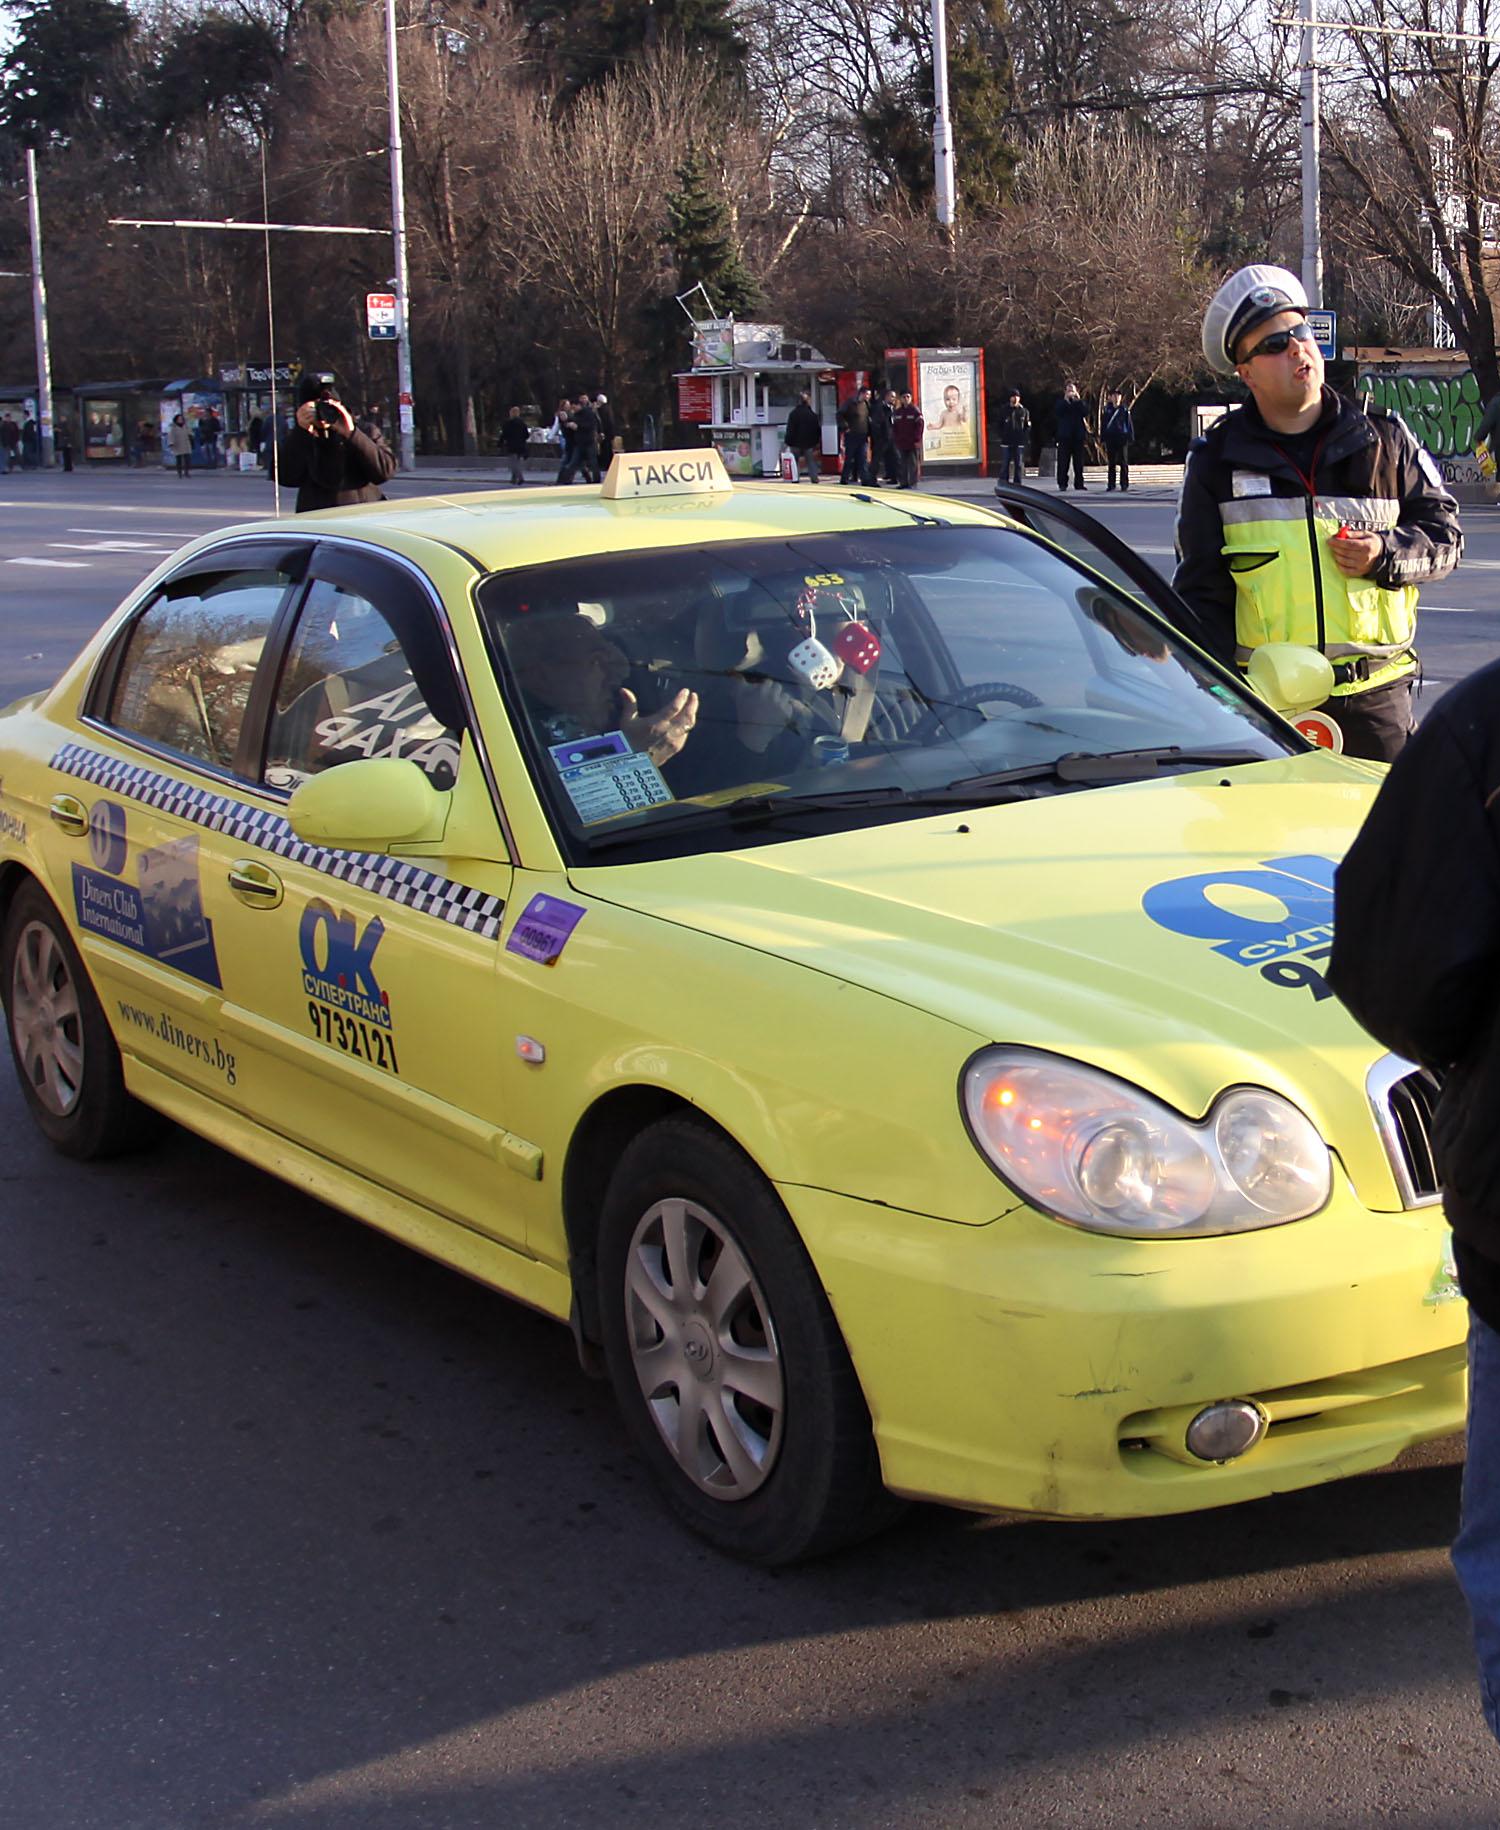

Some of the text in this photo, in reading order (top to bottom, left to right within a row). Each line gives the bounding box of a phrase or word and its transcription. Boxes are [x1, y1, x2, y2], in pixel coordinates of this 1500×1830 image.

[628, 461, 713, 486] ТАКСИ
[82, 875, 137, 920] Diners Club
[82, 900, 145, 946] International
[304, 973, 390, 1028] СУПЕРТРАНС
[117, 1000, 237, 1086] www.diners.bg
[308, 1001, 399, 1074] 9732121
